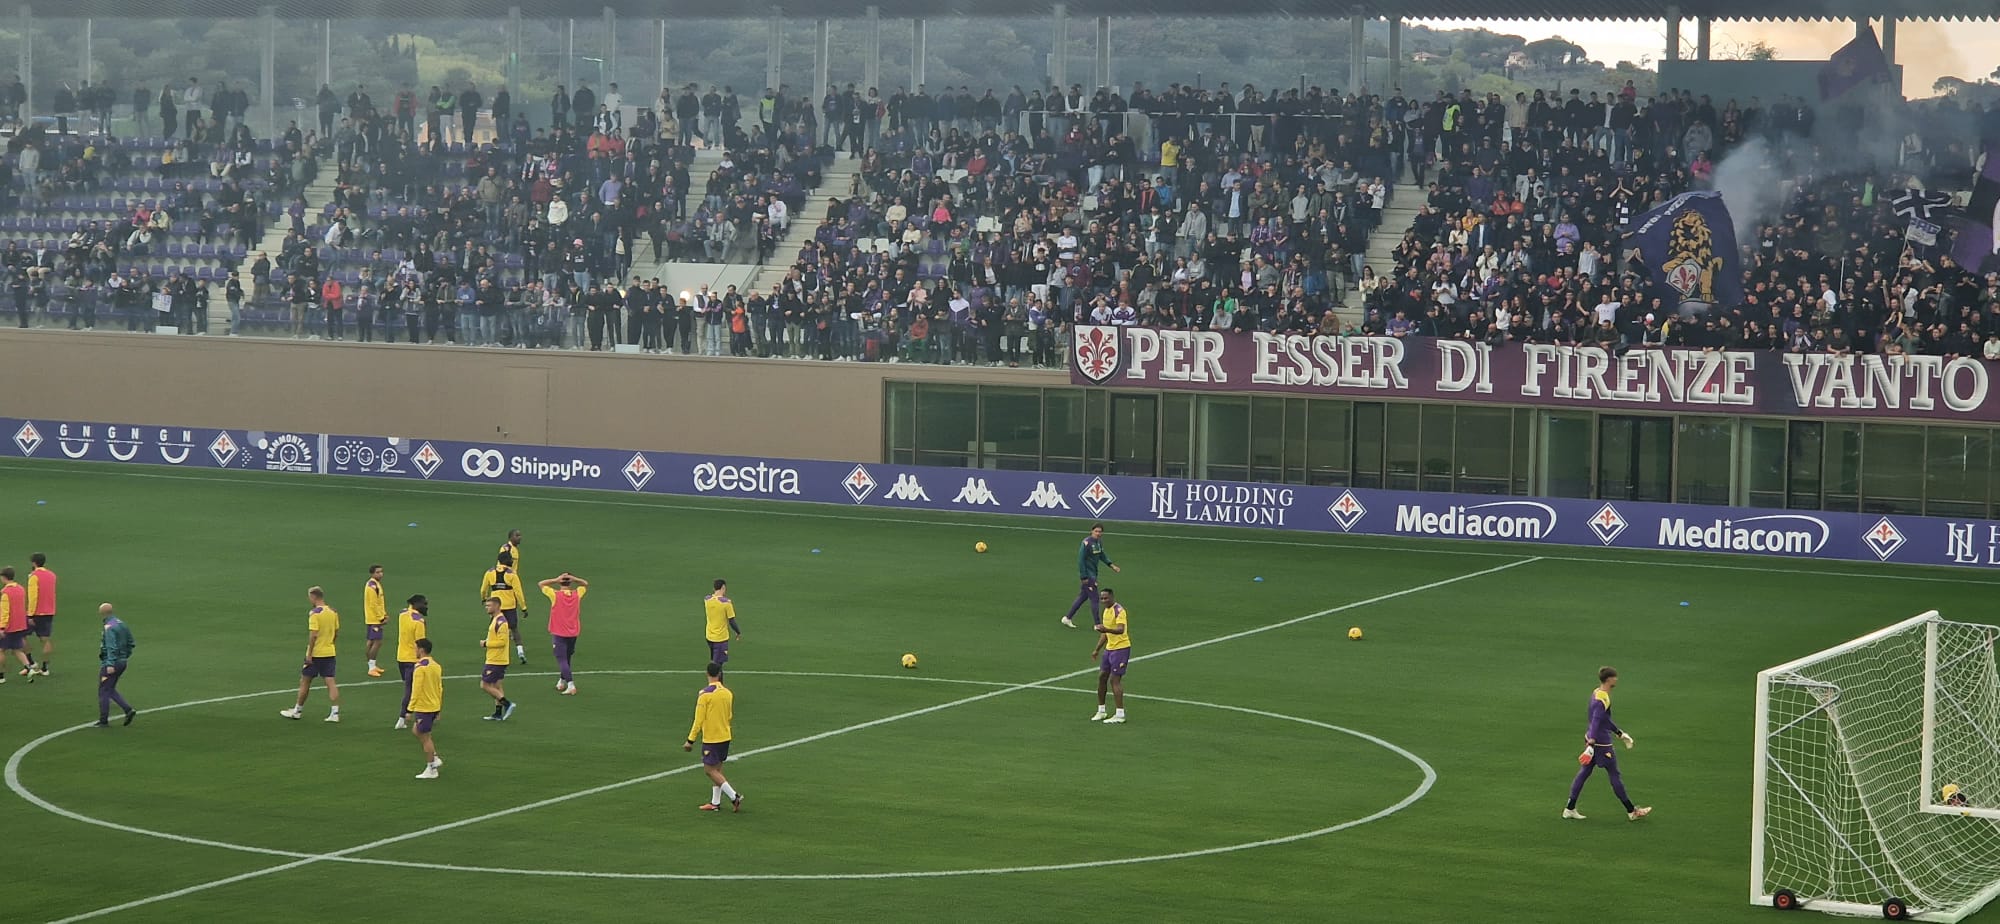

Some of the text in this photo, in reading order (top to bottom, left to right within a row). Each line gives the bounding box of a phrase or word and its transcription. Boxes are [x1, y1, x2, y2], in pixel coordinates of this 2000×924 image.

[1126, 328, 1989, 412] PER ESSER DI FIRENZE VANTO
[266, 433, 312, 462] SAMMONTANA
[510, 456, 601, 481] ShippyPro
[718, 462, 801, 494] estra
[1185, 484, 1294, 507] HOLDING
[1185, 503, 1285, 526] LAMIONI
[1395, 504, 1541, 538] Mediacom
[1658, 518, 1812, 553] Mediacom
